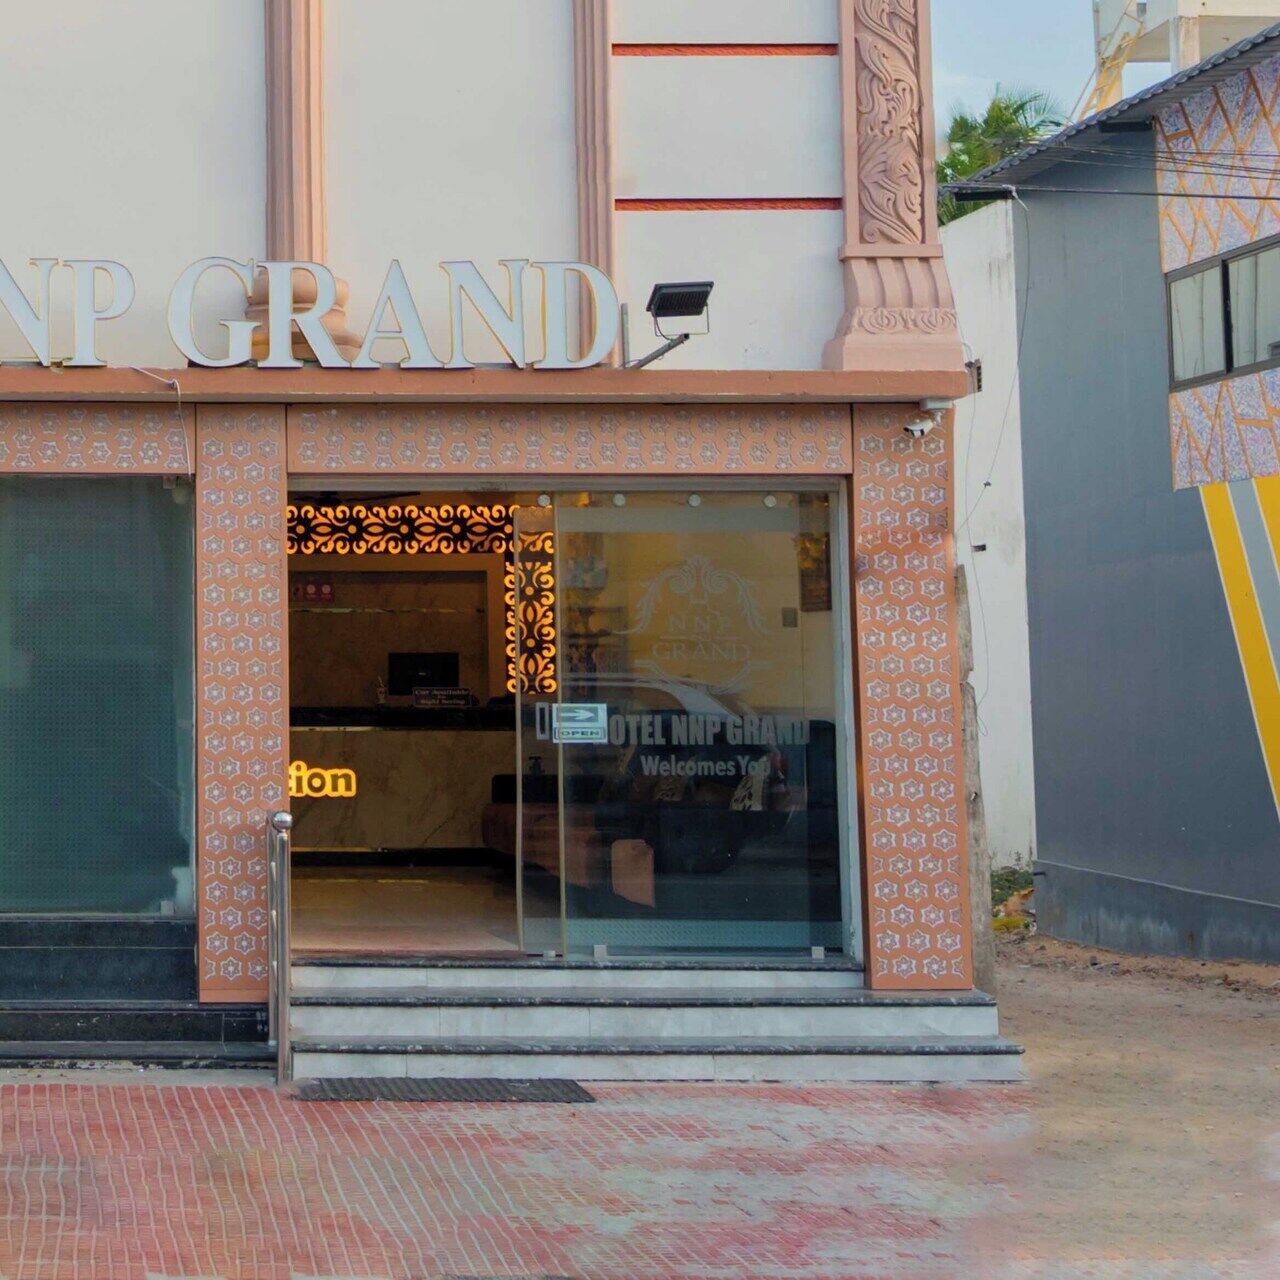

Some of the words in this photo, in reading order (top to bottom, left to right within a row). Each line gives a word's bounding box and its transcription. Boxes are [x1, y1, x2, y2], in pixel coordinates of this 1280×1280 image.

[167, 256, 620, 369] GRAND
[607, 714, 666, 745] OTEL
[671, 714, 721, 745] NNP
[726, 714, 810, 745] GRAND
[289, 761, 356, 797] ion
[640, 755, 735, 777] Welcomes
